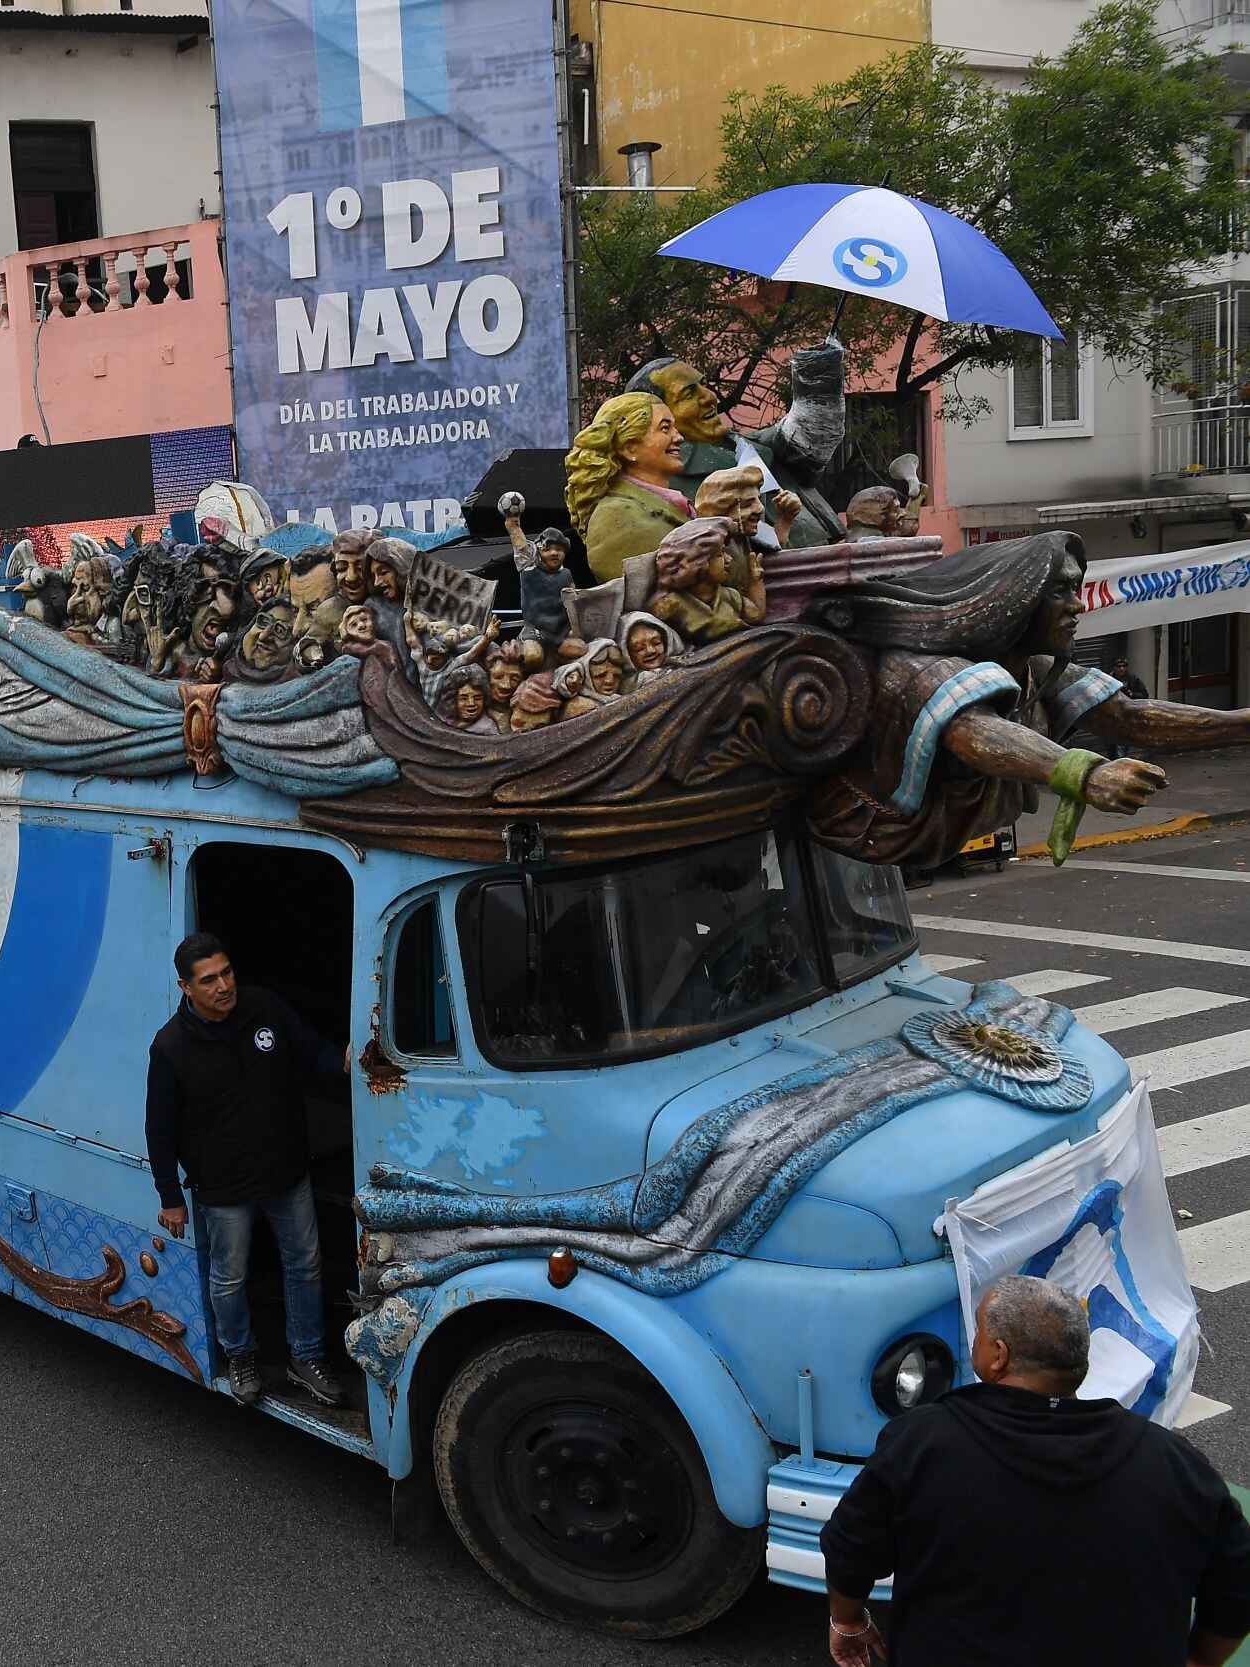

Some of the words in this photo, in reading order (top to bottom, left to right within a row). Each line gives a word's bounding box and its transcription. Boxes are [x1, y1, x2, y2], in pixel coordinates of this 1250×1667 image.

[382, 166, 505, 270] DE
[275, 274, 524, 374] MAYO
[279, 398, 316, 425] DÍA
[320, 396, 358, 422] DEL
[360, 386, 501, 418] TRABAJADOR
[505, 383, 520, 404] Y
[309, 432, 334, 454] LA
[337, 419, 491, 452] TRABAJADORA
